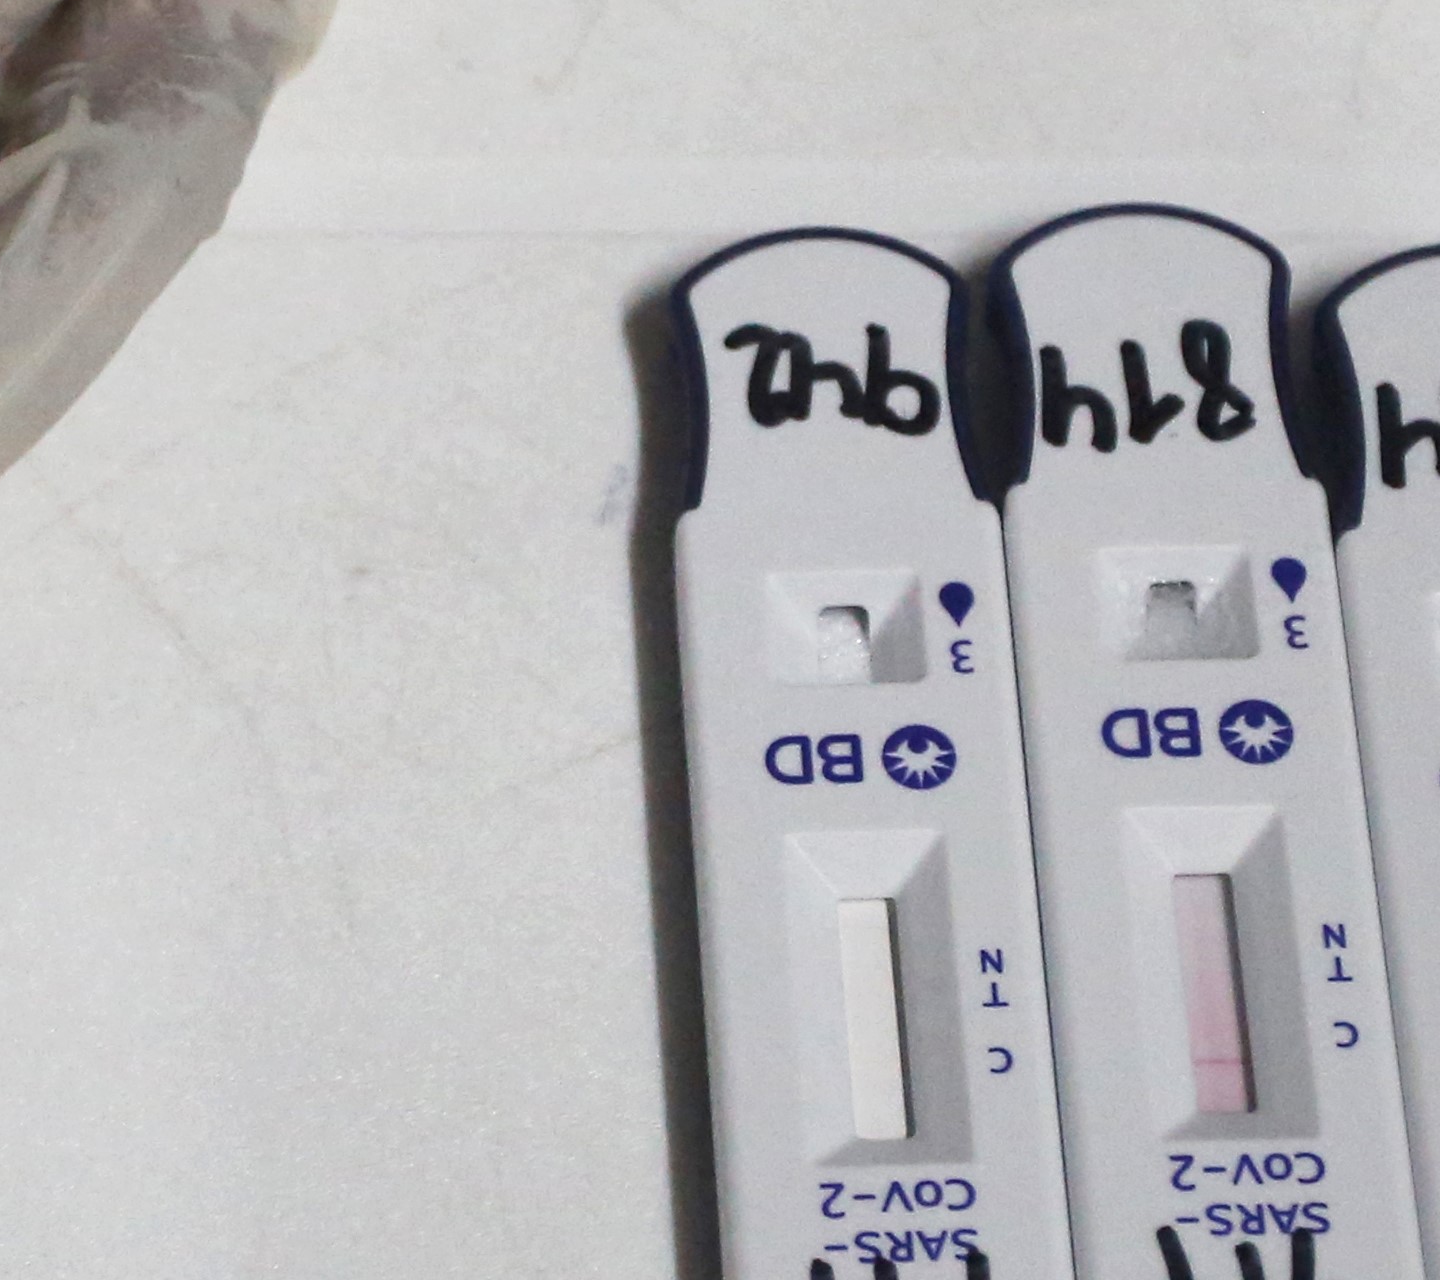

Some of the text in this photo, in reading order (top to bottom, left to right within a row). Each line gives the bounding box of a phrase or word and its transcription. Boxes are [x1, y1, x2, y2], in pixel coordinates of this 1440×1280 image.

[1039, 320, 1254, 453] 814
[1283, 614, 1310, 650] 3
[948, 638, 973, 674] 3
[1099, 707, 1204, 759] BD
[764, 733, 865, 785] BD
[1322, 923, 1348, 950] N
[979, 949, 1005, 974] N
[1327, 955, 1355, 983] T
[985, 982, 1009, 1009] T
[1334, 1019, 1361, 1050] C
[991, 1045, 1016, 1076] C
[1170, 1151, 1327, 1193] CoV-2
[819, 1177, 978, 1220] CoV-2
[1176, 1201, 1332, 1238] SARS-
[824, 1227, 978, 1265] SARS-
